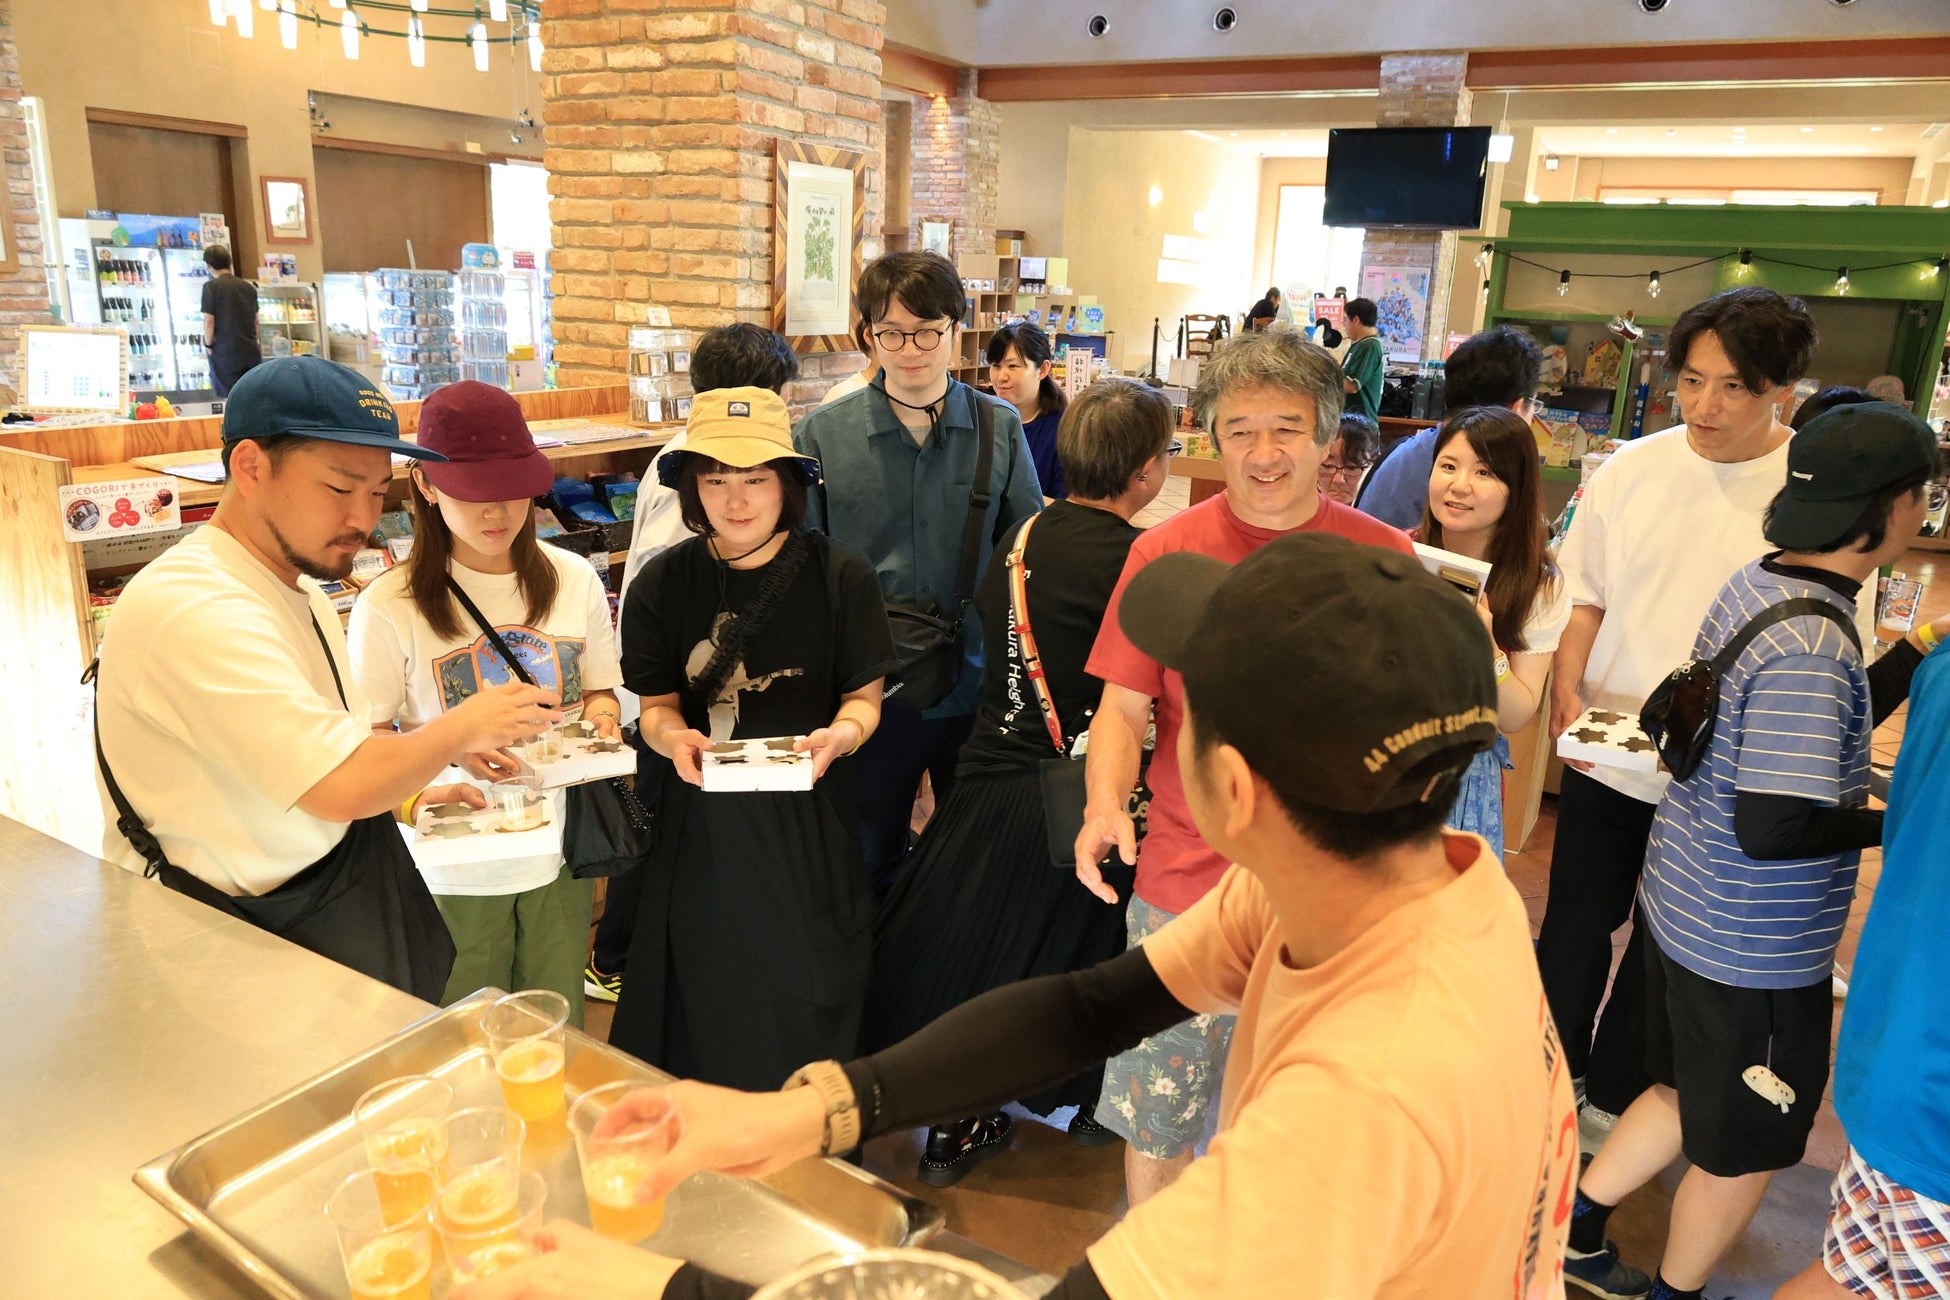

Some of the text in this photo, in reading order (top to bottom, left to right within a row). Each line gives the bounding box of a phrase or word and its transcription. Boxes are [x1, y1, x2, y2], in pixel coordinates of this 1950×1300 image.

[1318, 307, 1340, 315] SALE
[1007, 603, 1018, 658] akura
[513, 651, 528, 659] eer
[1004, 662, 1026, 722] Heights
